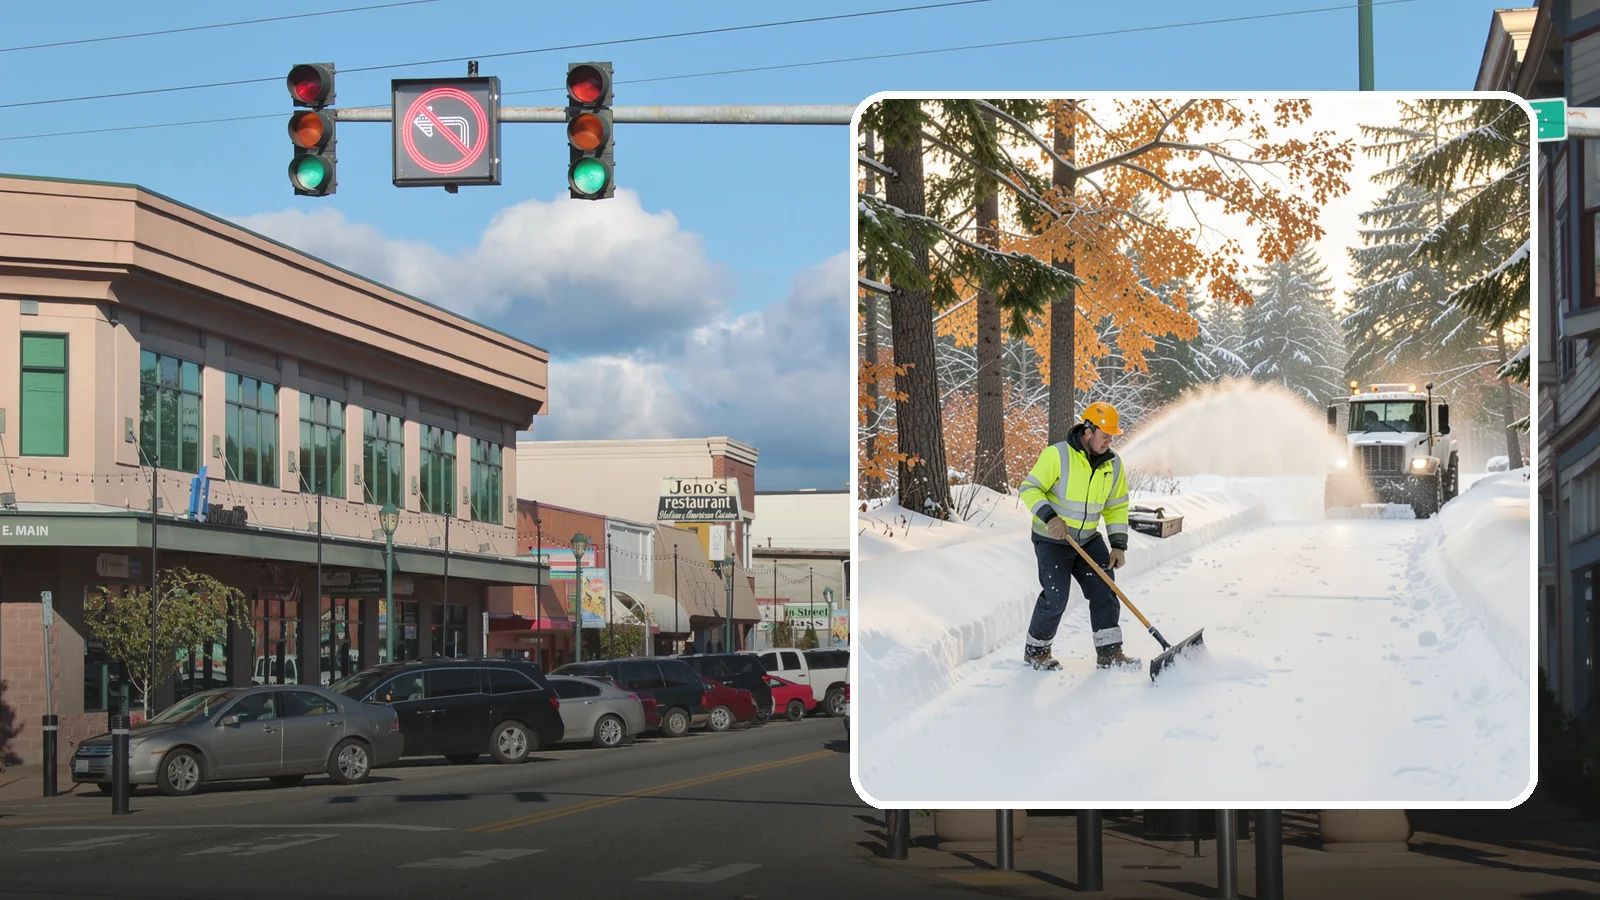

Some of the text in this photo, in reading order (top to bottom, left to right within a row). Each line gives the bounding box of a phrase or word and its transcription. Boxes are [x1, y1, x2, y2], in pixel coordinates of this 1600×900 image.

[669, 479, 727, 494] Jeno's
[665, 496, 731, 509] restaurant
[658, 510, 681, 520] Italian
[686, 509, 714, 519] American
[715, 509, 738, 519] Cuisine
[2, 525, 49, 536] E. MAIN
[786, 607, 828, 617] in Street
[791, 619, 823, 627] lass
